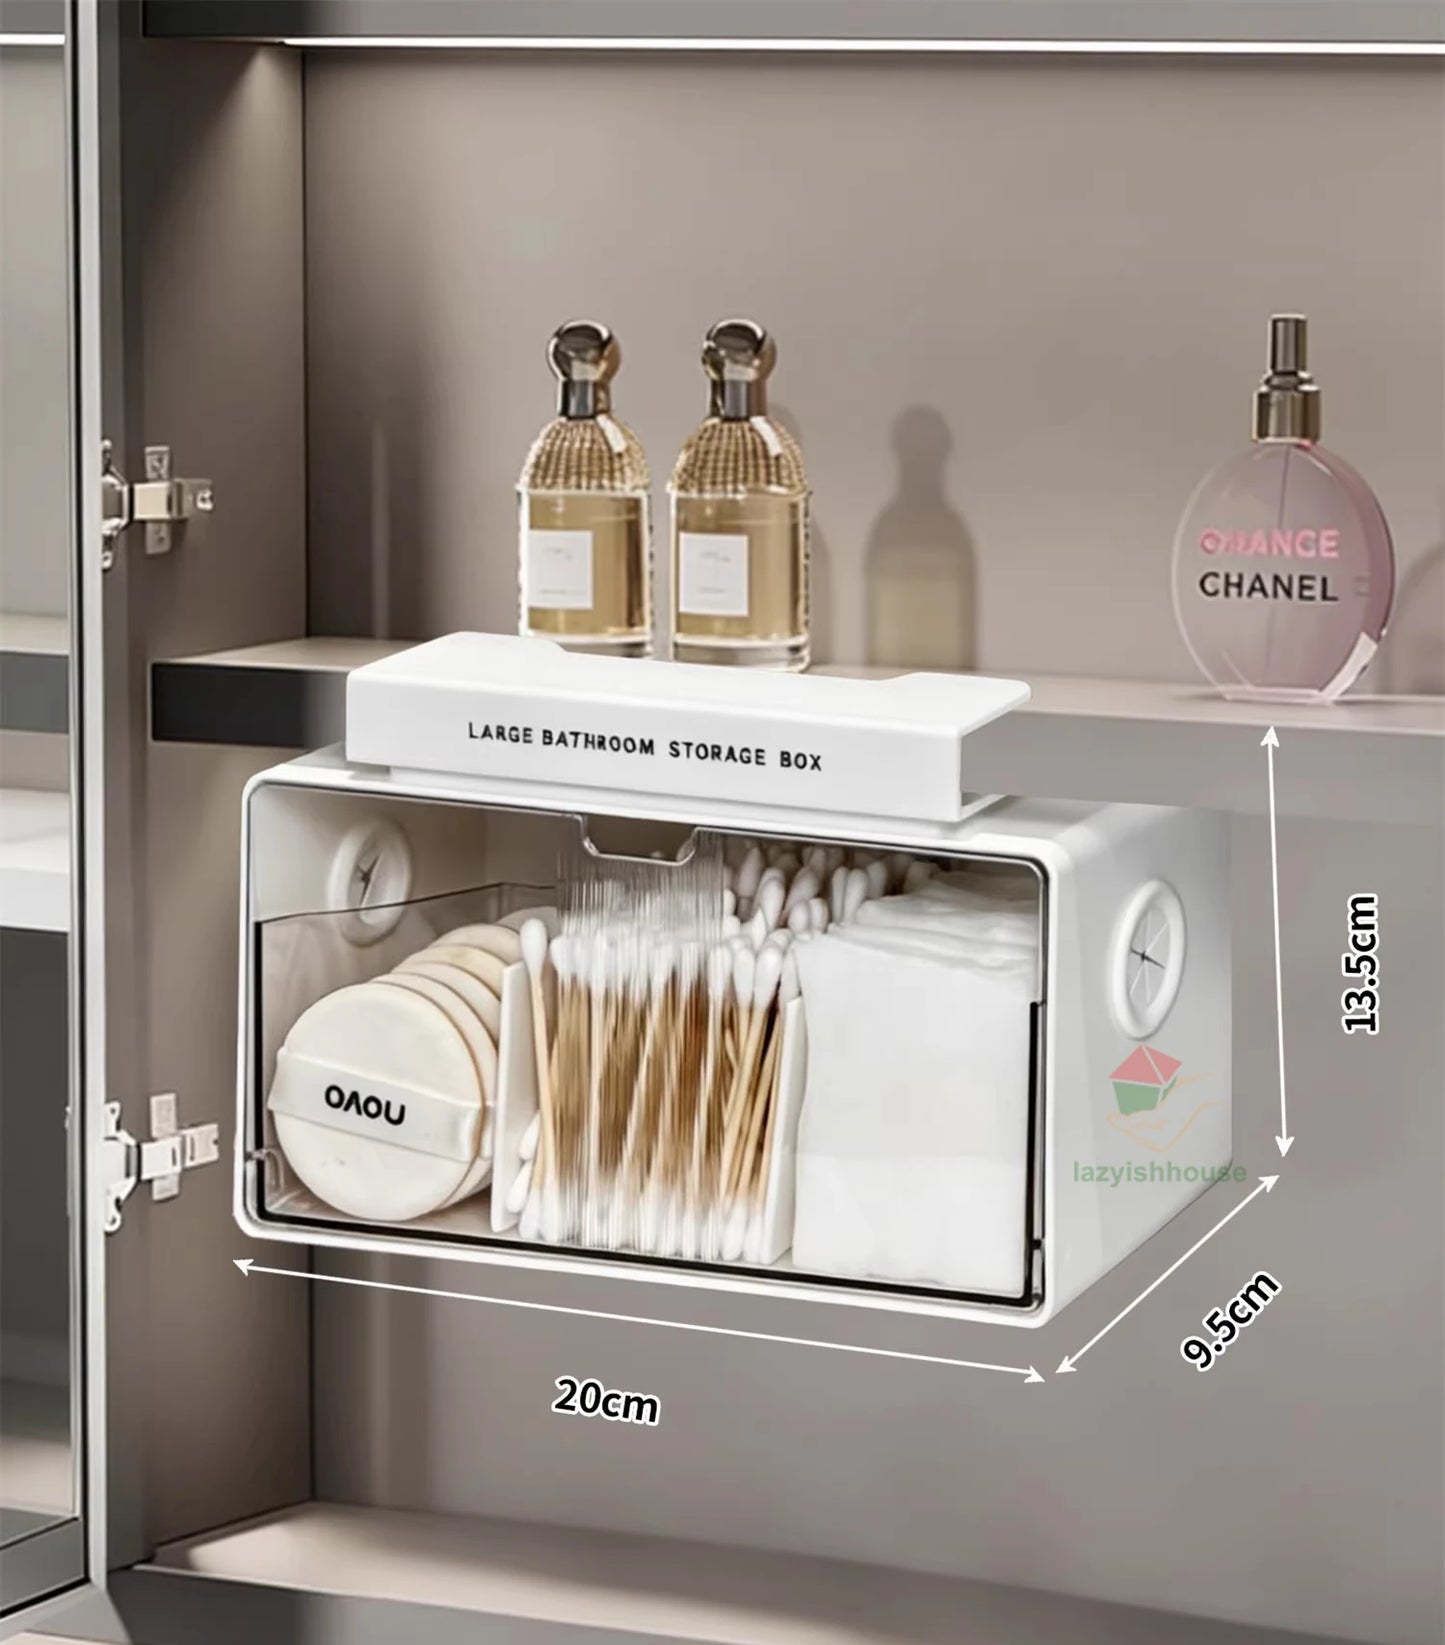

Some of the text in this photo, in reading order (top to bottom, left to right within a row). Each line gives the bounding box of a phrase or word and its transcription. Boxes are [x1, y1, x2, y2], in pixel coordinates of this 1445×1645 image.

[1199, 571, 1340, 602] CHANEL
[468, 721, 822, 772] LARGE BATHROOM STORAGE BOX
